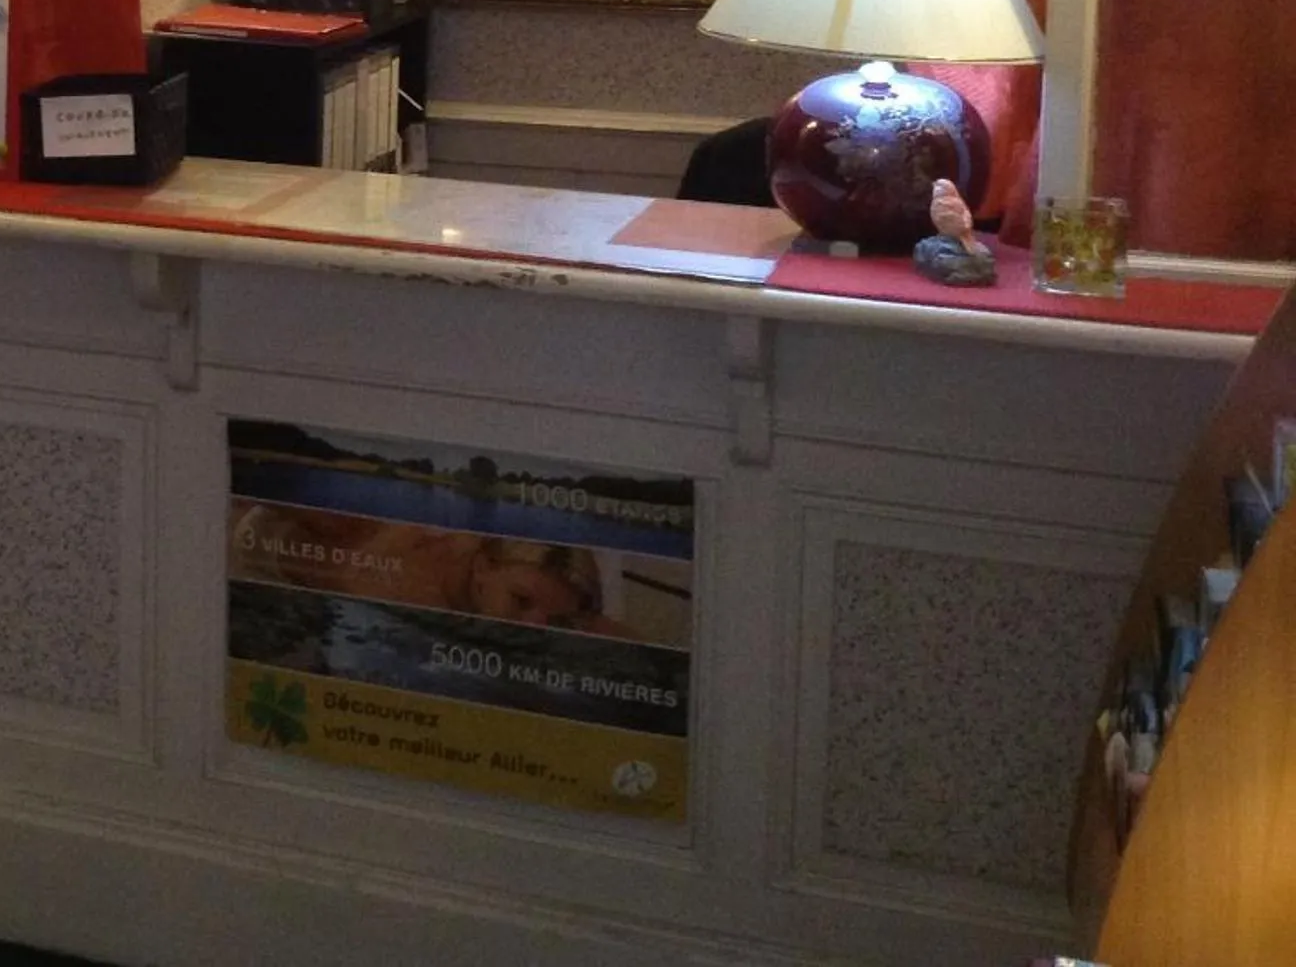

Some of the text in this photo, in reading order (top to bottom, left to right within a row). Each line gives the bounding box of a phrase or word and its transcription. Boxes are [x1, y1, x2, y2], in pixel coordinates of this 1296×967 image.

[518, 480, 588, 513] 1000
[240, 525, 404, 573] 3 VILLES D'EAUX
[429, 640, 503, 678] 5000
[508, 662, 539, 684] KM
[545, 669, 574, 689] DE
[322, 690, 442, 728] Découvrez
[321, 722, 381, 748] votre
[388, 735, 483, 765] meilleur
